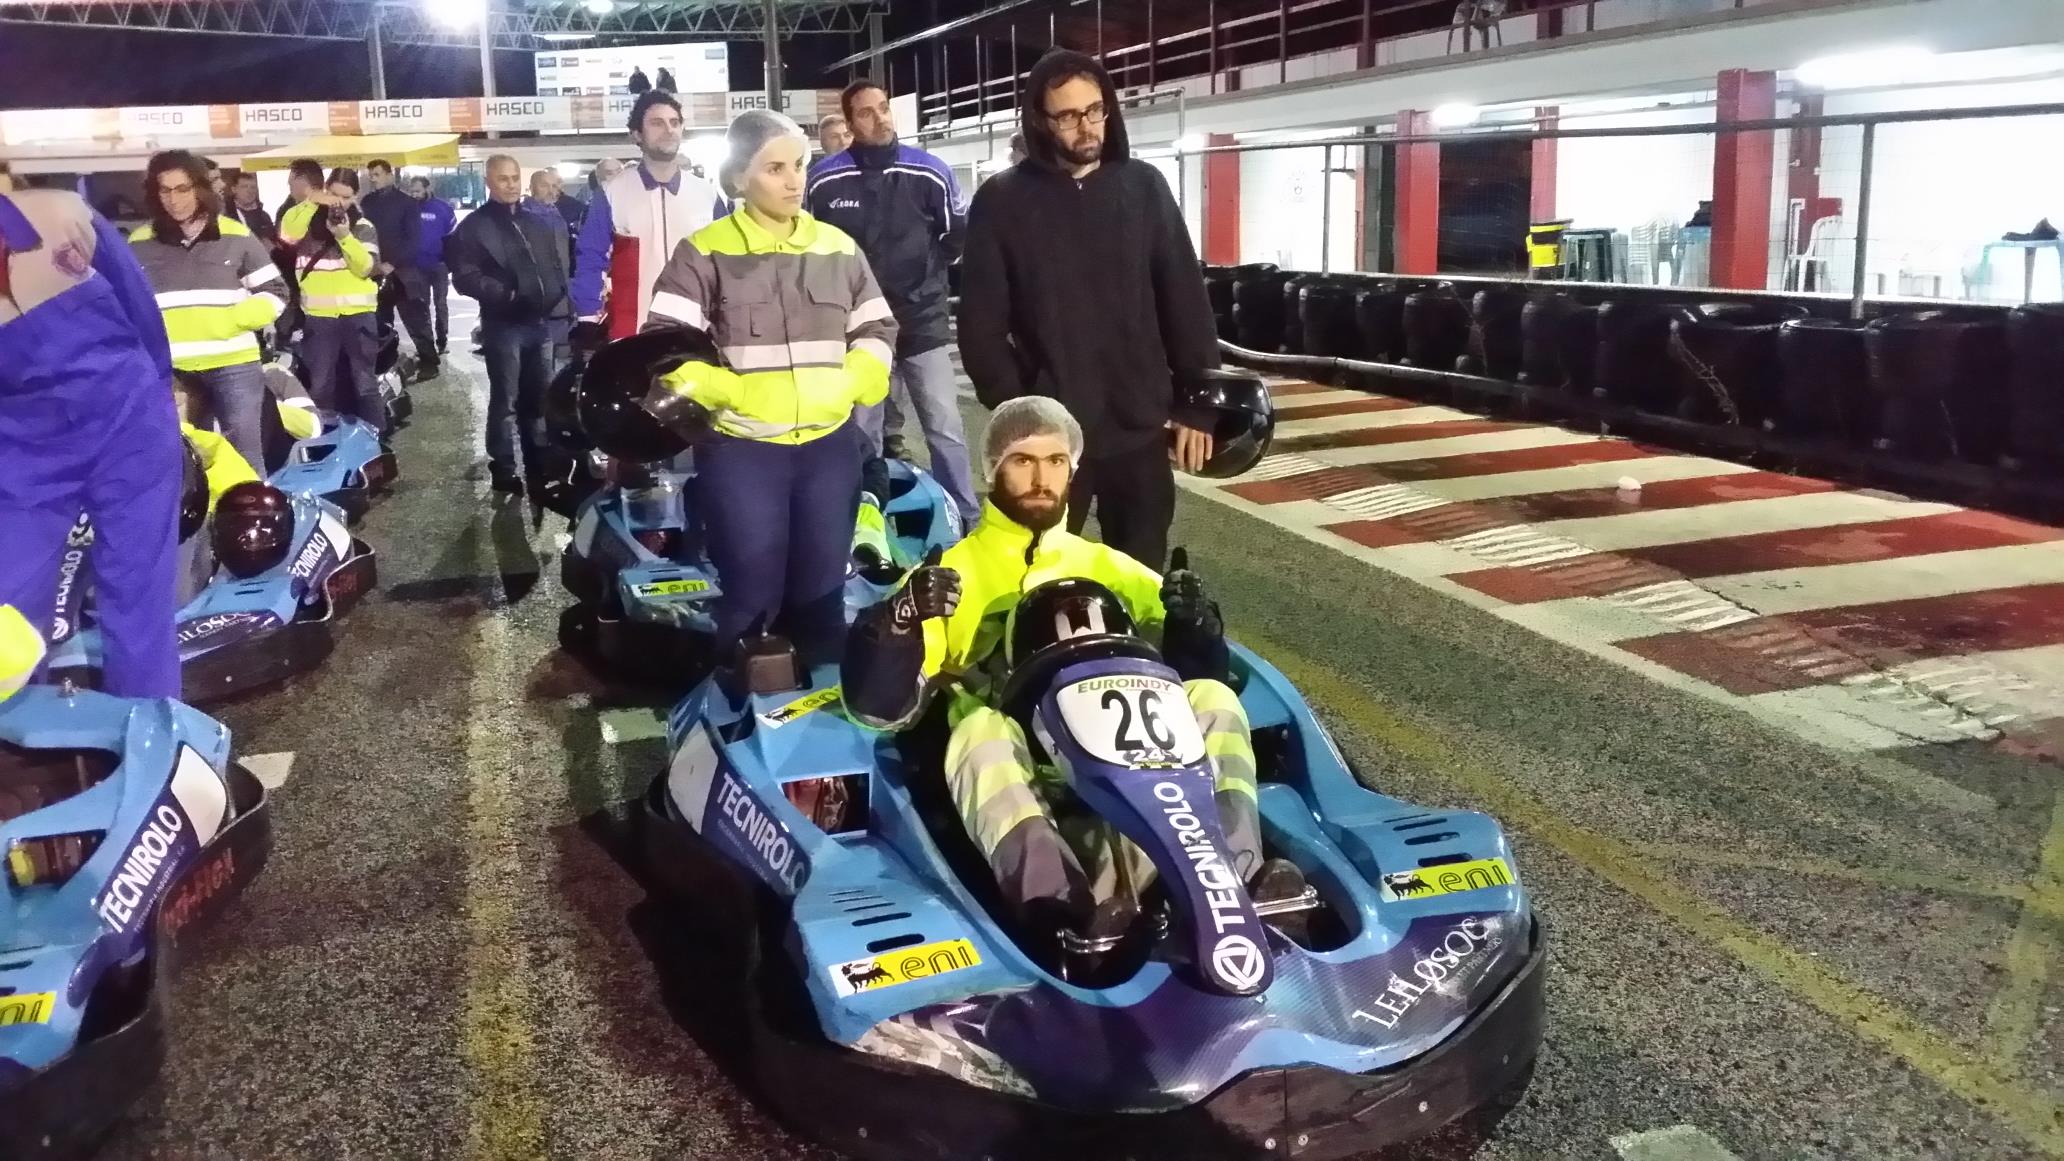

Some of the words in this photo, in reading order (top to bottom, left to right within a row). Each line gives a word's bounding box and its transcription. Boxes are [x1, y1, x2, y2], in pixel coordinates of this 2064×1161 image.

[246, 108, 302, 122] HASCO
[365, 105, 422, 119] HASCO
[486, 102, 544, 116] HASCO
[731, 96, 790, 109] HASO
[134, 112, 183, 125] ASCO
[803, 690, 840, 708] en
[1078, 679, 1171, 694] EUROINDY
[1101, 689, 1176, 751] 26
[717, 772, 806, 893] TECNIROLO
[100, 805, 183, 934] TECNIROLO
[1154, 781, 1246, 934] TECNIROLO
[1438, 859, 1508, 893] eni
[900, 939, 973, 981] eni
[0, 992, 43, 1025] ni
